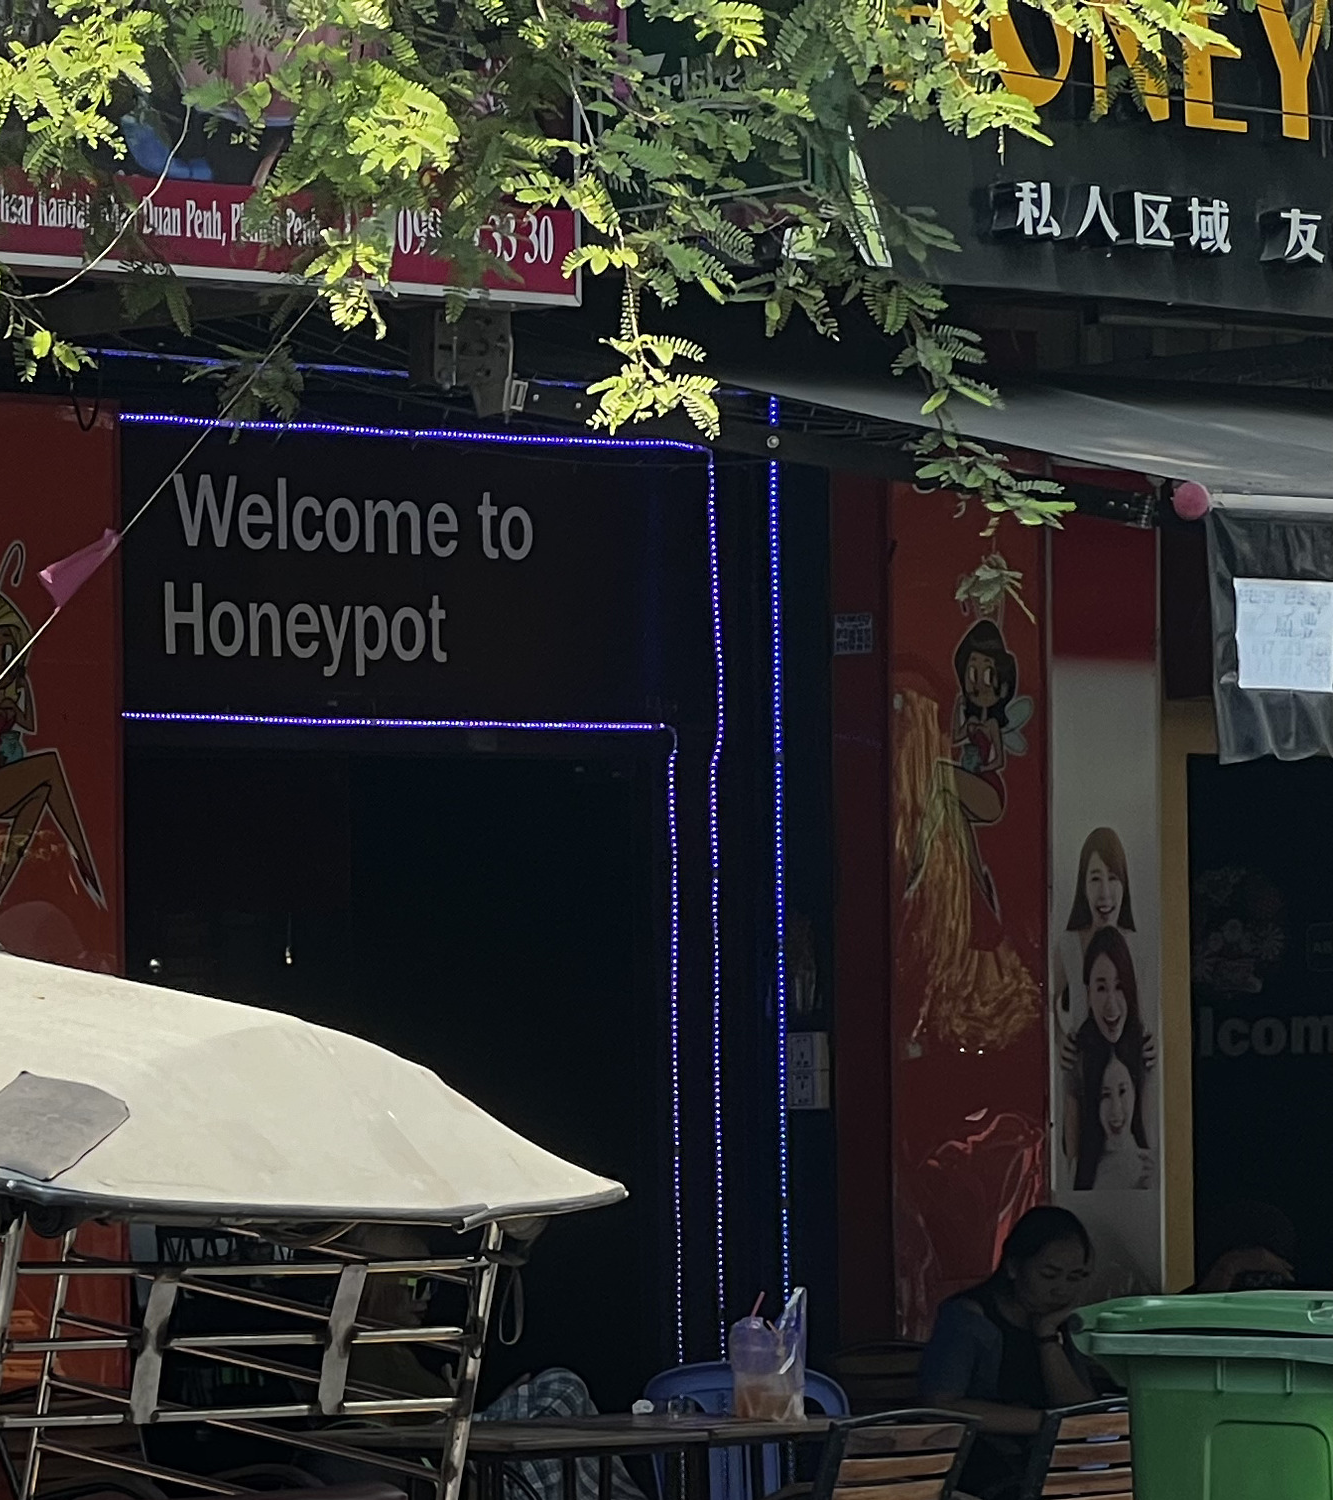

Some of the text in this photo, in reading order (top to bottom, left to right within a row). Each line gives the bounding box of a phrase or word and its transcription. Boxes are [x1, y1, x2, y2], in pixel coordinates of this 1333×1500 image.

[901, 0, 1318, 140] ONEY
[186, 199, 226, 247] Penh,
[1015, 181, 1325, 263] 私人区域 友
[173, 473, 534, 561] Welcome to
[164, 581, 448, 677] Honeypot
